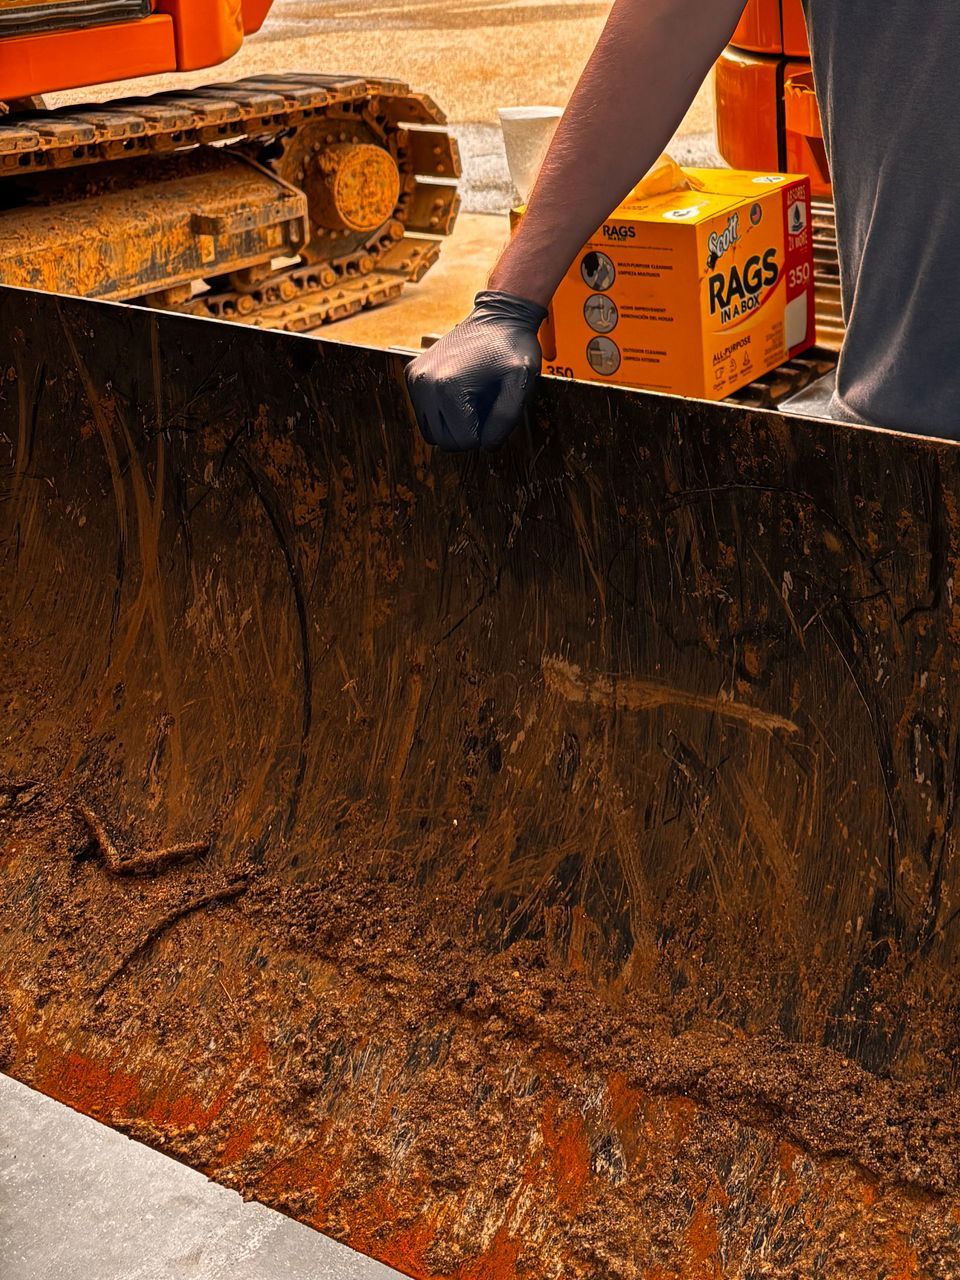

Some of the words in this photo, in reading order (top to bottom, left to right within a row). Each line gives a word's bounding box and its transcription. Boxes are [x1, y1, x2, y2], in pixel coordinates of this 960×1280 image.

[602, 224, 636, 238] RAGS
[708, 212, 739, 258] Scott
[708, 247, 778, 315] RAGS
[788, 262, 810, 288] 350
[720, 307, 731, 324] IN
[732, 303, 739, 318] A
[740, 293, 761, 315] BOX
[712, 335, 751, 363] ALL-PURPOSE
